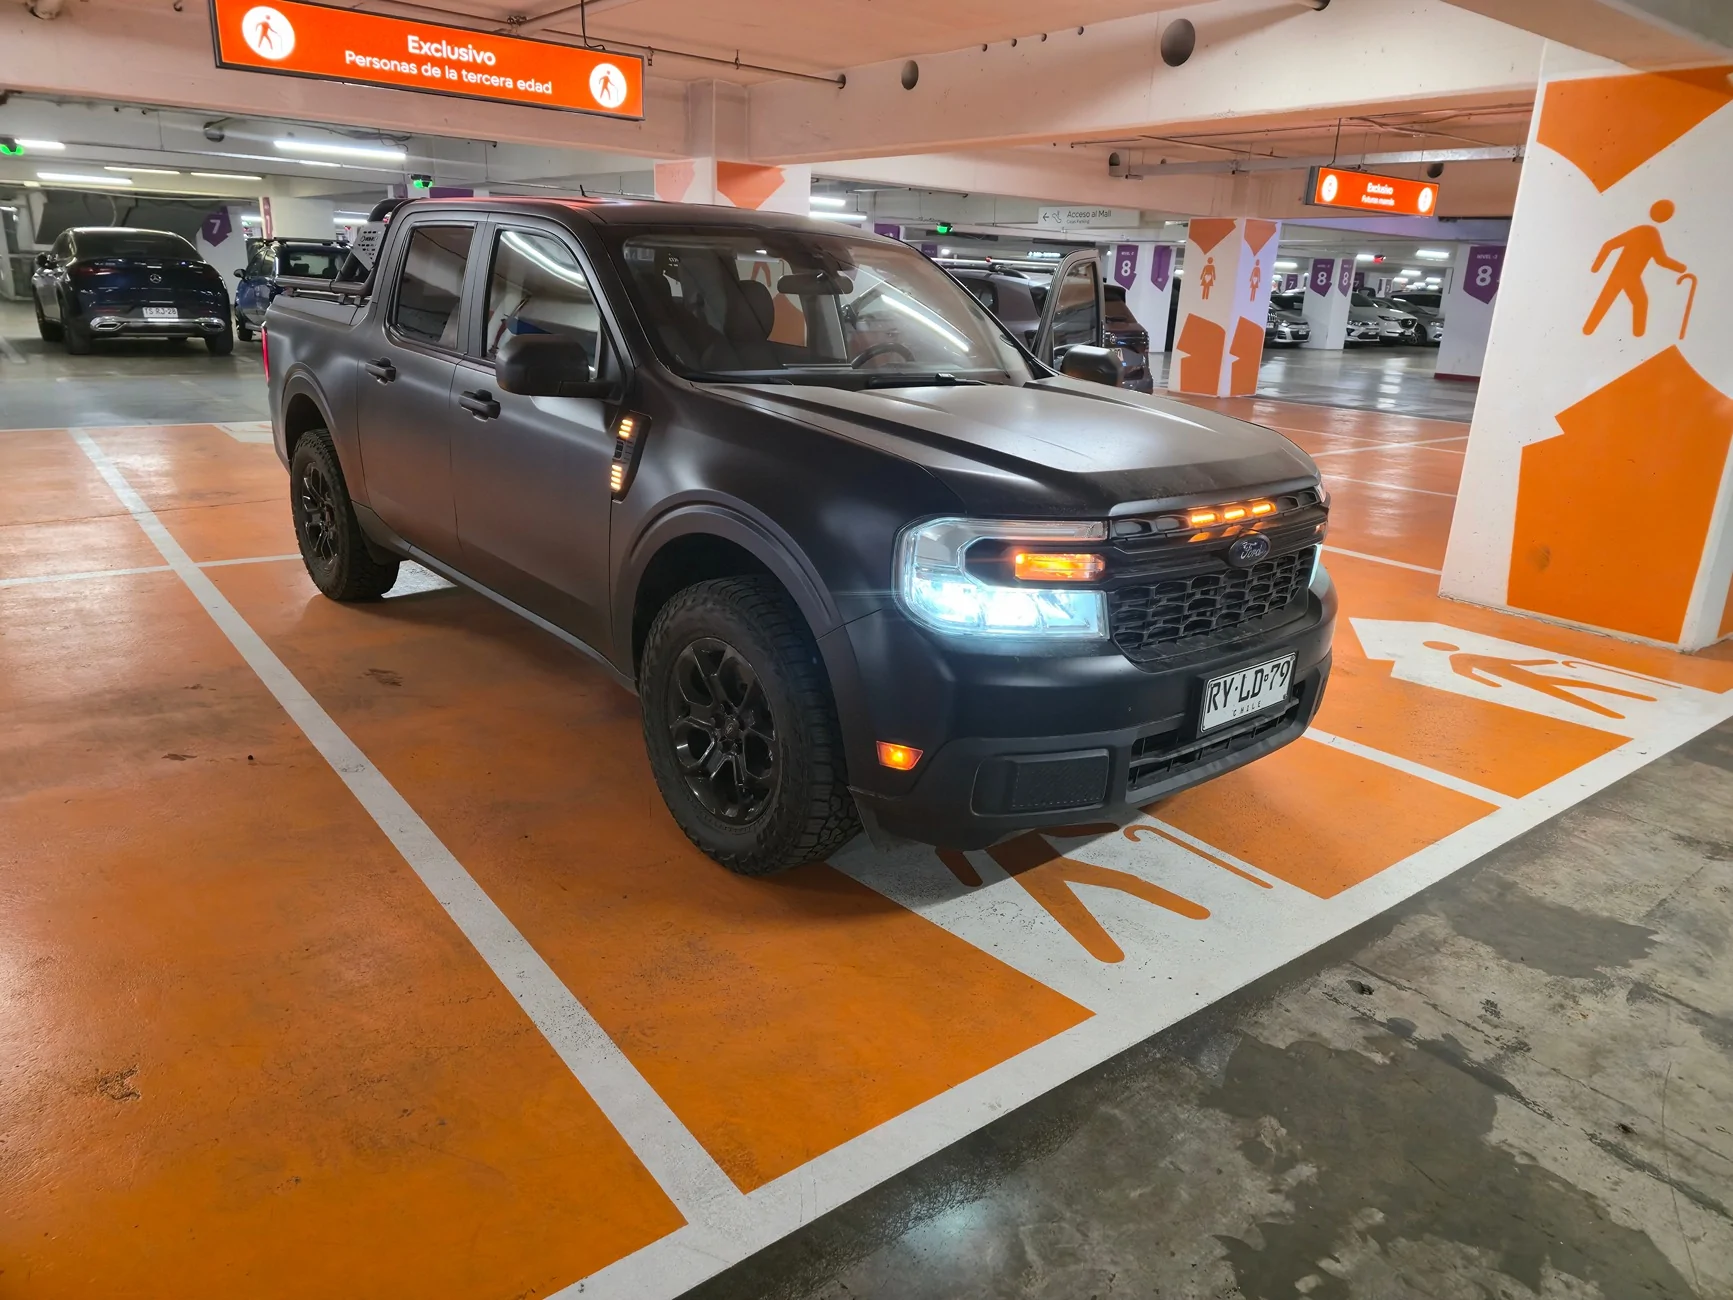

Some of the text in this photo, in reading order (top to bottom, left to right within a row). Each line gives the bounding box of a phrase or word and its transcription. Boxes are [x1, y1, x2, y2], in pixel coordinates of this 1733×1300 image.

[407, 34, 496, 66] Exclusivo
[345, 50, 553, 95] Personas de la tercera edad
[1067, 210, 1112, 219] Acceso al Mall
[209, 219, 221, 234] 7
[1121, 260, 1131, 276] 8
[1475, 265, 1492, 287] 8
[1317, 271, 1327, 286] 8
[1342, 271, 1349, 286] 8
[1240, 540, 1264, 560] Ford
[1232, 700, 1262, 717] CHILE
